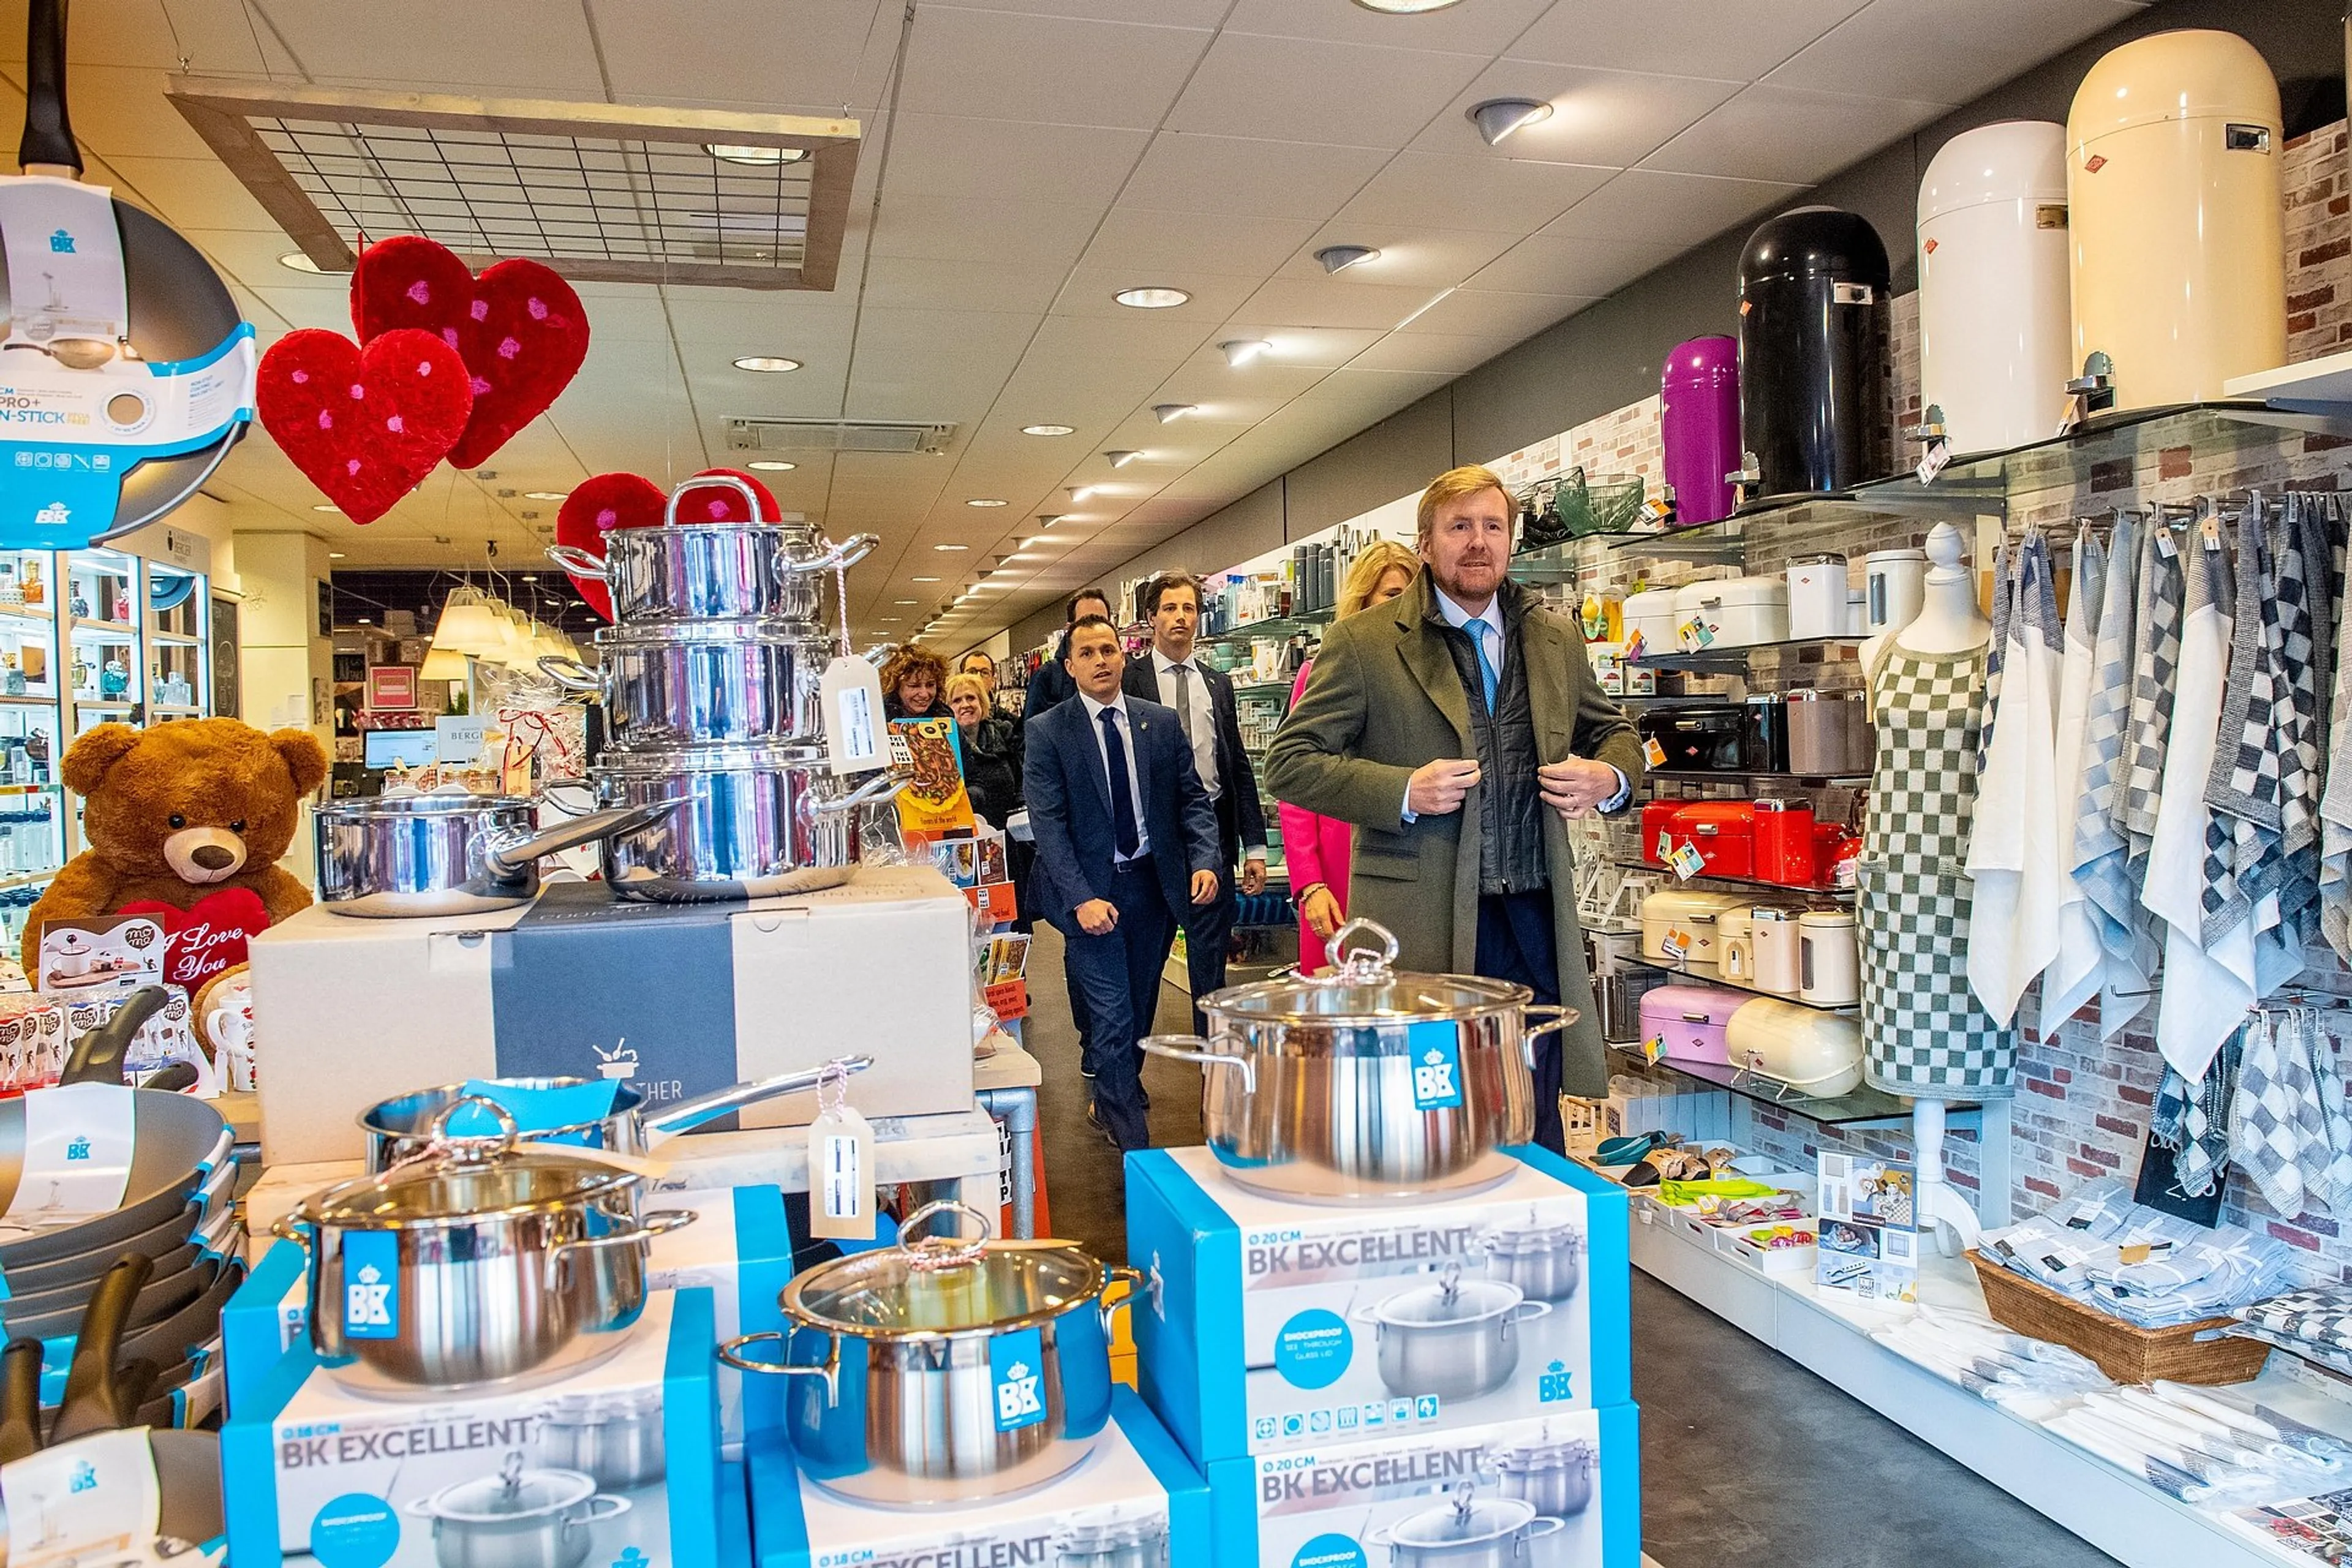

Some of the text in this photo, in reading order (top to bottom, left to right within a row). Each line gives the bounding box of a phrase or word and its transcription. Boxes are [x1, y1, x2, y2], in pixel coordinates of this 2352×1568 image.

[50, 236, 77, 254] BK
[35, 509, 72, 524] BK
[181, 922, 244, 953] Love
[173, 949, 227, 981] You
[1414, 1063, 1457, 1101] BK
[67, 1143, 91, 1160] BK
[1248, 1226, 1472, 1275] BK EXCELLENT
[1262, 1233, 1278, 1245] 20
[1280, 1231, 1302, 1242] CM
[348, 1284, 391, 1325] BK
[998, 1374, 1041, 1420] BK
[1539, 1371, 1573, 1402] BK
[282, 1439, 329, 1469] BK
[338, 1416, 533, 1464] EXCELLENT
[314, 1423, 341, 1436] CM
[1262, 1471, 1305, 1502] BK
[1312, 1446, 1484, 1496] EXCELLENT
[1276, 1459, 1292, 1471] 20
[1294, 1455, 1316, 1468] CM
[834, 1553, 848, 1566] 18
[851, 1550, 873, 1563] CM
